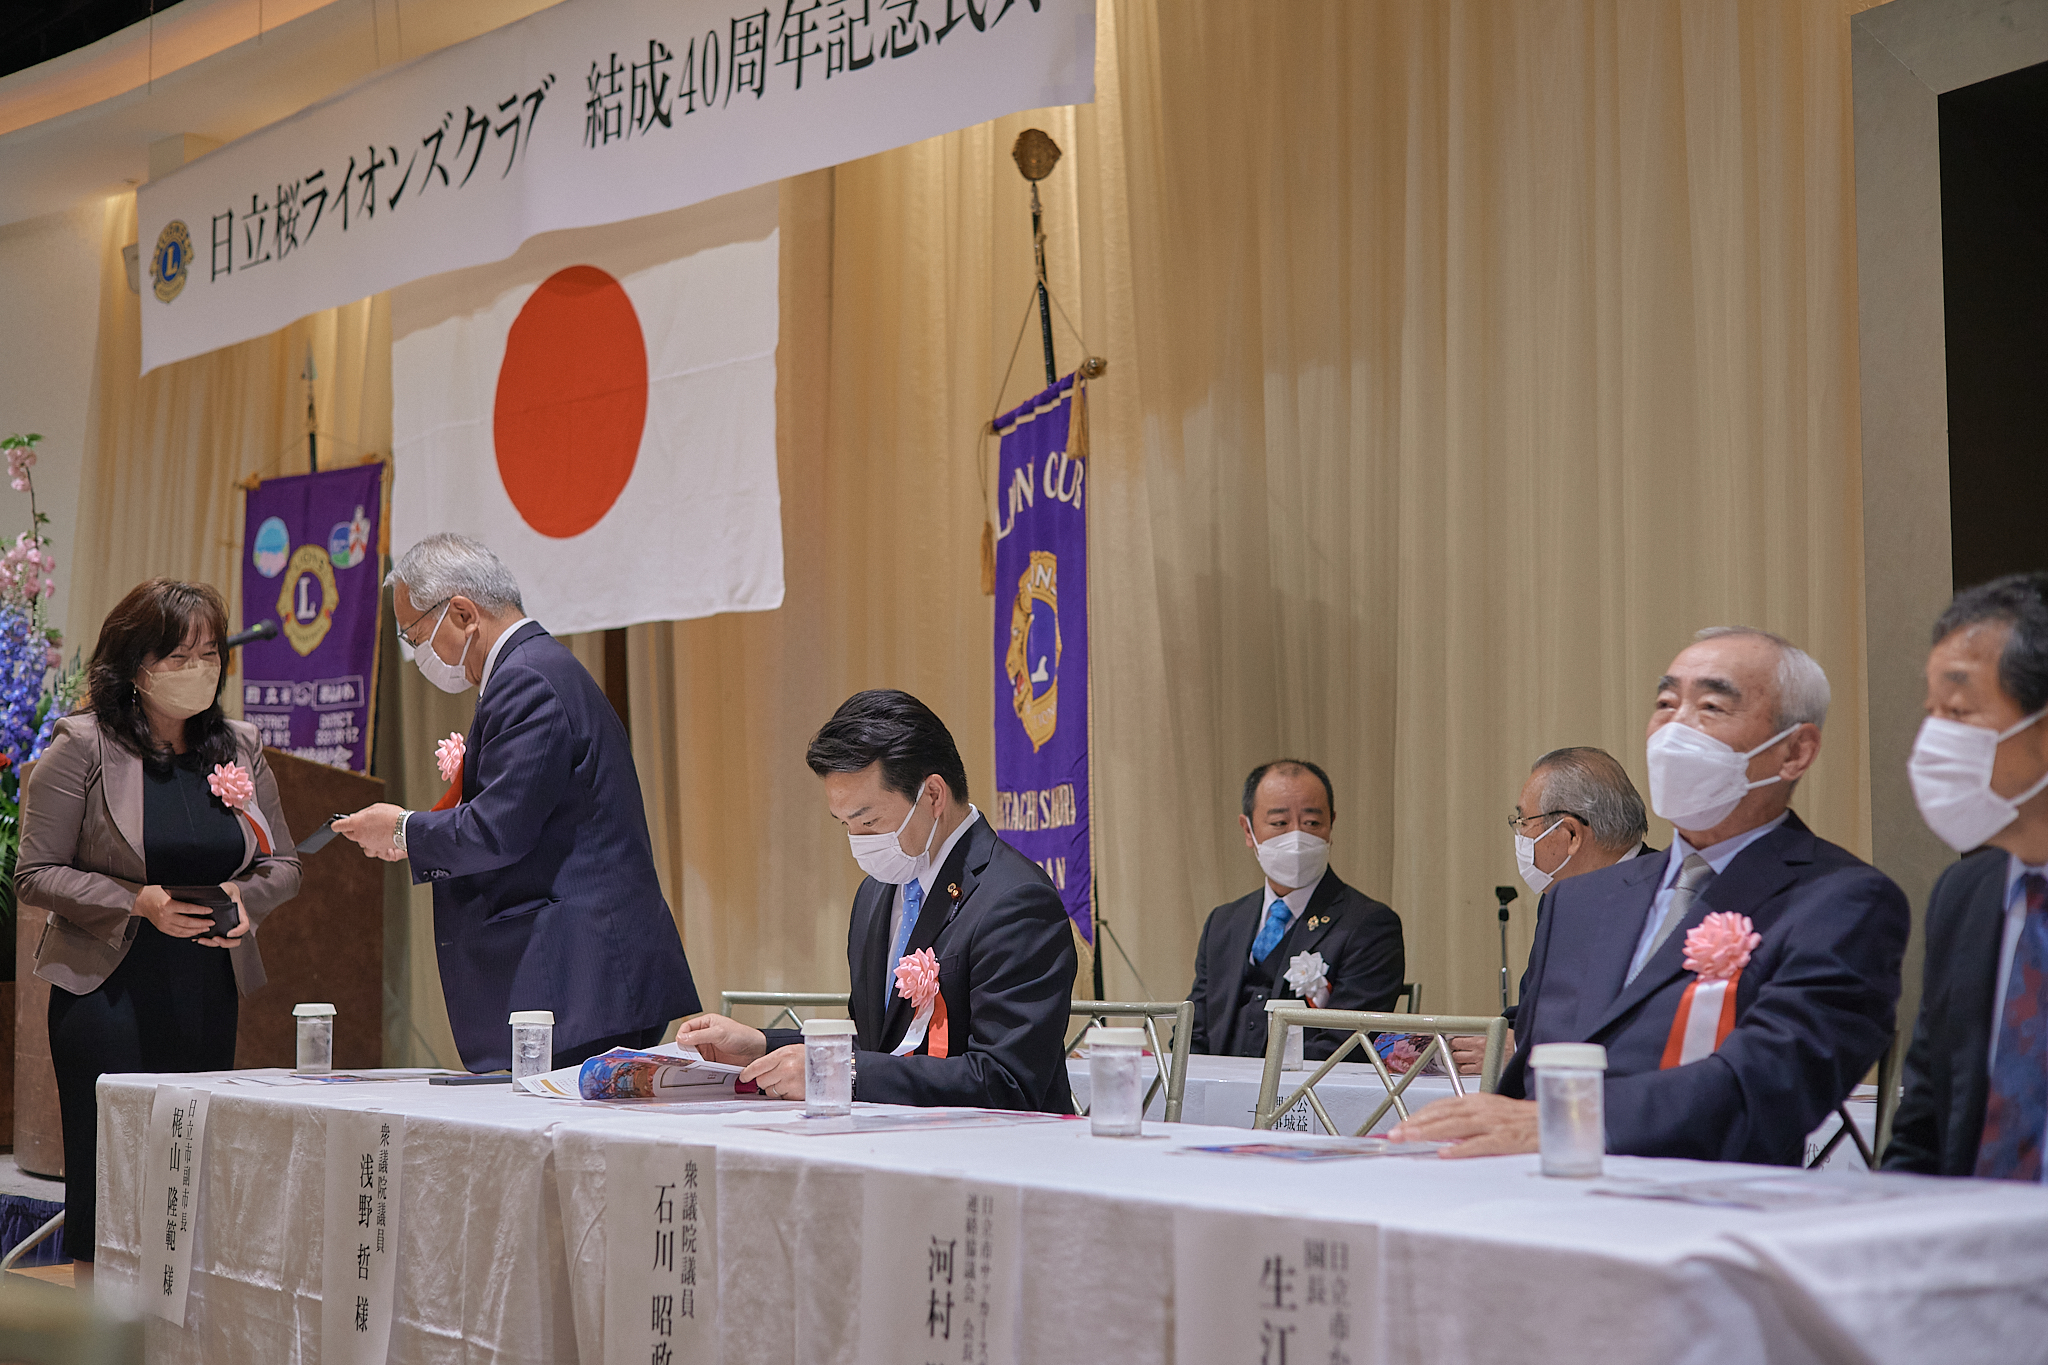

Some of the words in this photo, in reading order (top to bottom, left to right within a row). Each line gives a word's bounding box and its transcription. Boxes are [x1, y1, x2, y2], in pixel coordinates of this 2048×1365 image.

[211, 73, 556, 282] 日立桜ライオンズクラブ
[165, 245, 178, 277] L
[297, 577, 316, 620] L
[358, 1153, 374, 1229] 浅野
[376, 1123, 391, 1254] 衆議院議員
[652, 1182, 676, 1272] 石川
[357, 1243, 371, 1281] 哲
[681, 1160, 698, 1319] 衆議院議員
[355, 1295, 369, 1333] 様
[926, 1234, 957, 1341] 河村
